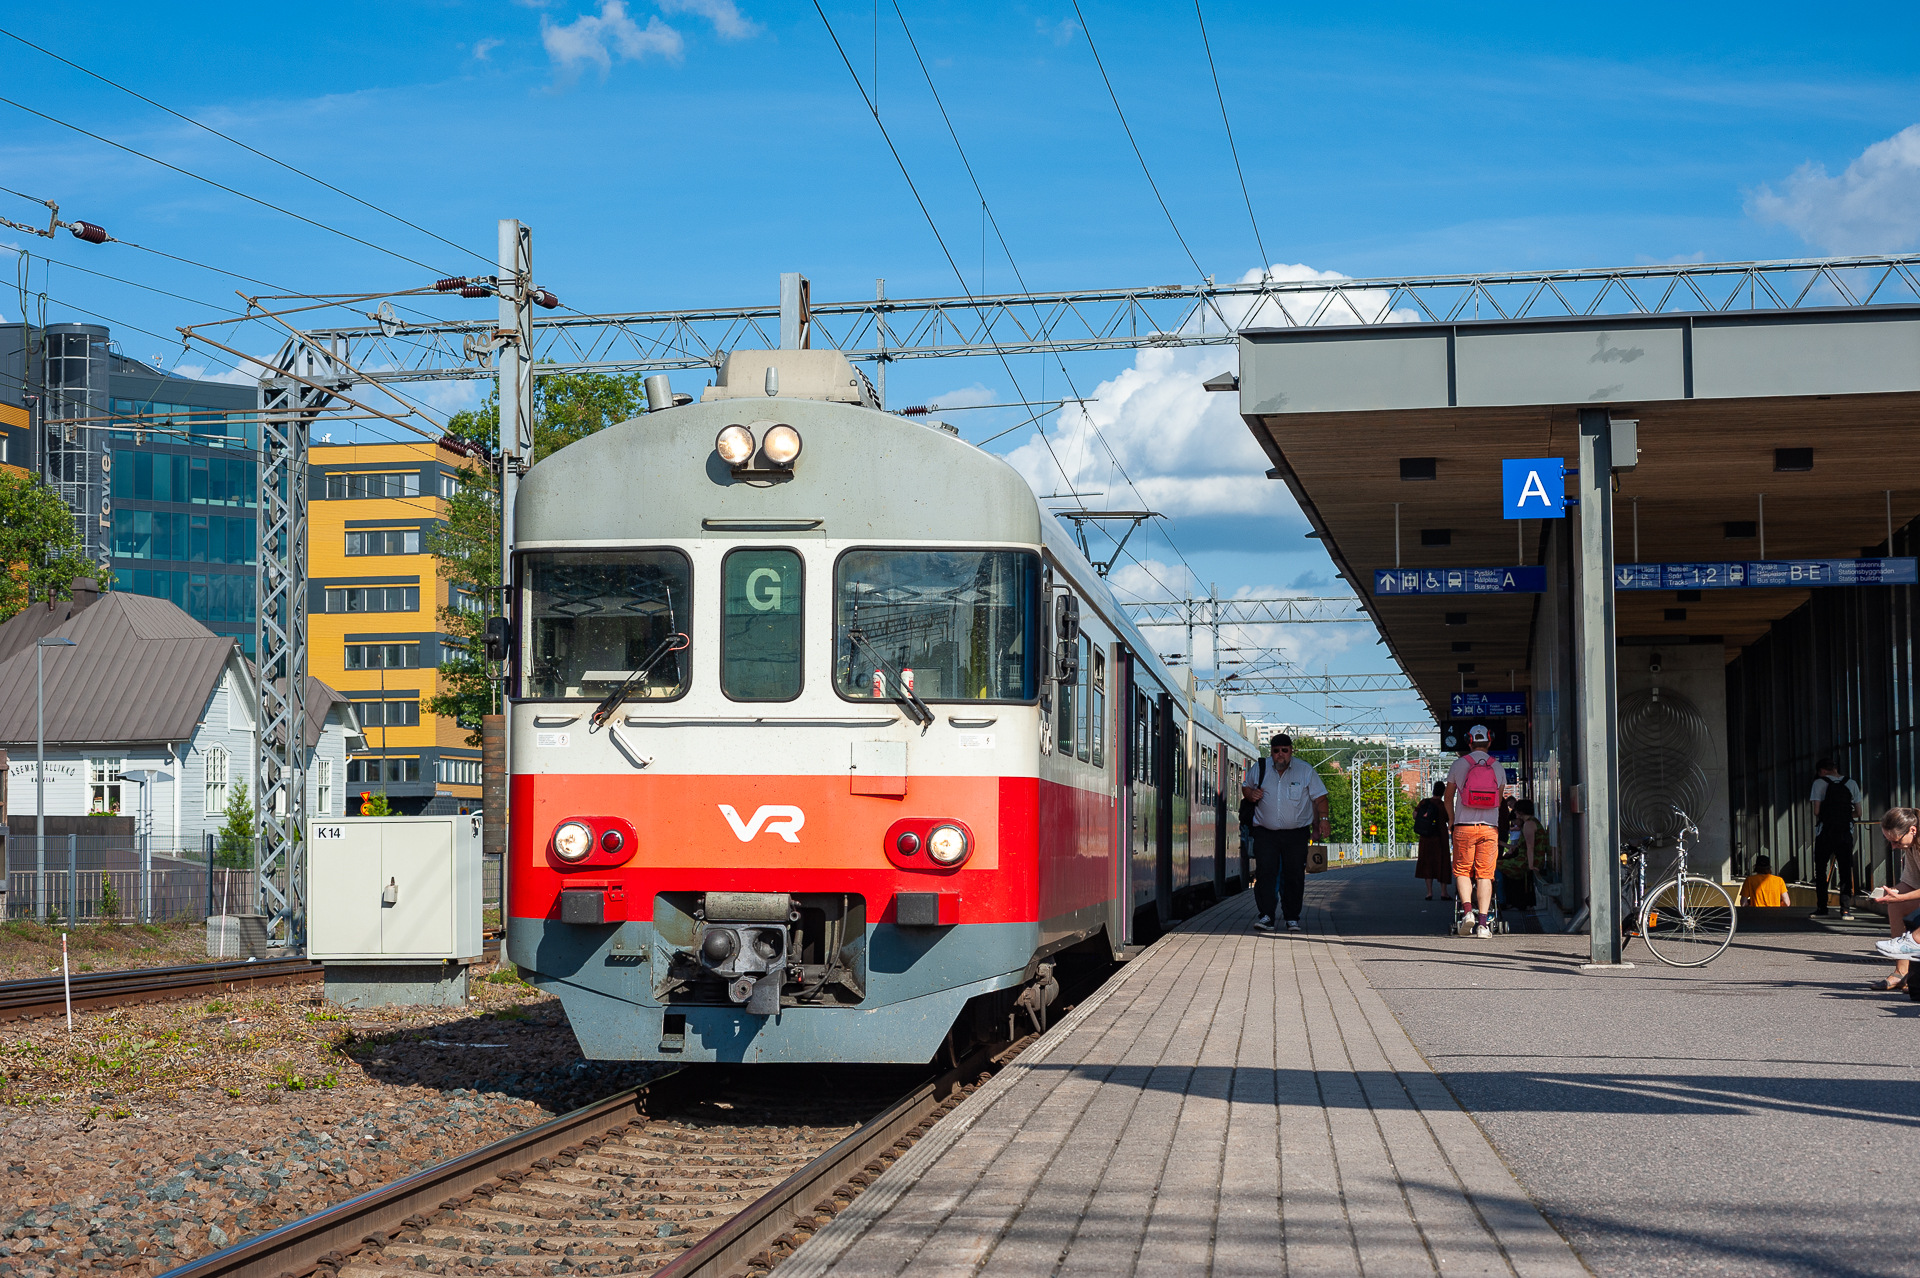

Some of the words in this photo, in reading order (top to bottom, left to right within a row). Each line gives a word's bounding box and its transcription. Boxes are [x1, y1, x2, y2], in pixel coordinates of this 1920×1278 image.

[100, 441, 111, 528] Tower
[1517, 470, 1552, 508] A
[1503, 571, 1516, 587] A
[1692, 567, 1717, 585] 1,2
[1790, 565, 1821, 581] B-E
[1859, 575, 1884, 583] building
[745, 567, 781, 611] G
[1481, 694, 1488, 703] A
[1447, 725, 1454, 734] 4
[1510, 734, 1520, 746] B
[717, 804, 805, 843] VR
[318, 827, 327, 839] K
[328, 827, 341, 839] 14
